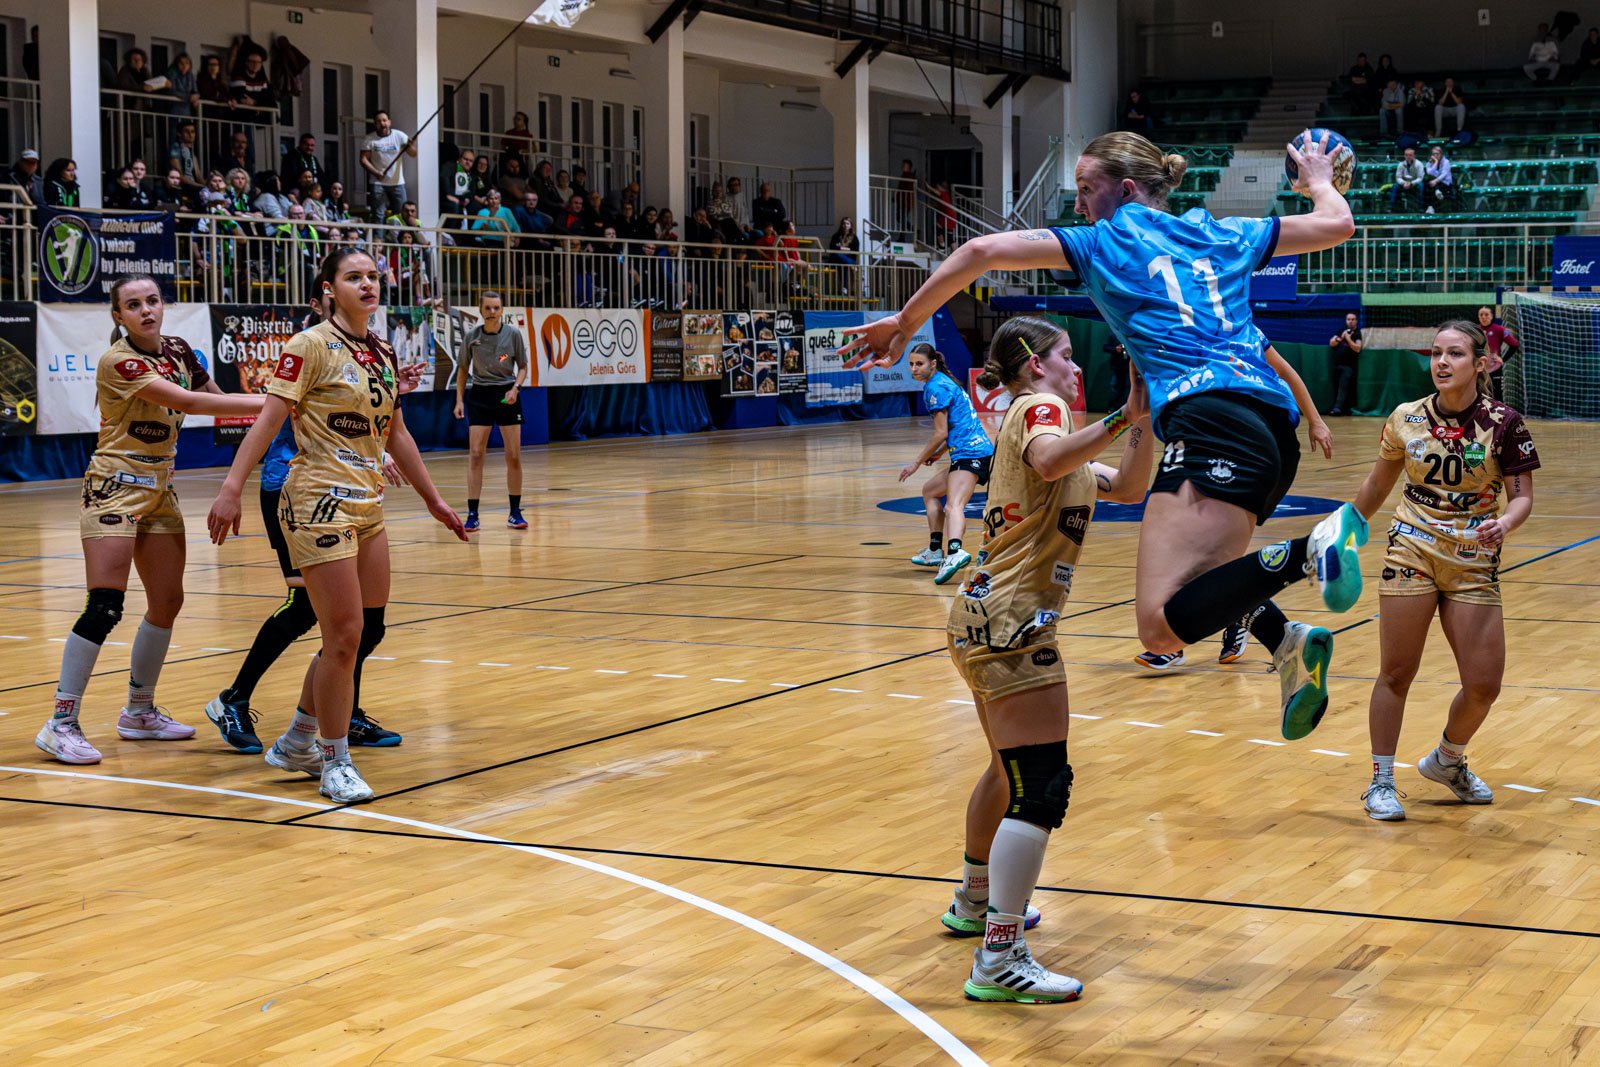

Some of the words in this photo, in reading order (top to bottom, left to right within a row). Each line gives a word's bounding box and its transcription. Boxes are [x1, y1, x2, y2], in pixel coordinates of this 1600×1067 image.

[140, 220, 164, 234] moc
[107, 239, 135, 253] wiara
[101, 258, 114, 274] by
[115, 258, 150, 274] Jelenia
[152, 258, 174, 275] Góra
[1555, 259, 1595, 274] Hotel
[1146, 255, 1233, 332] 11
[241, 316, 294, 338] Pizzeria
[653, 316, 680, 332] Catering
[572, 318, 638, 358] eco
[809, 329, 836, 354] quest
[217, 333, 285, 364] Gazow
[48, 354, 96, 372] JEL
[589, 362, 614, 377] Jelenia
[616, 361, 637, 375] Góra
[367, 377, 382, 408] 5
[334, 416, 369, 431] elmas
[1405, 415, 1424, 423] TICO
[134, 424, 167, 438] elmas
[1164, 440, 1185, 464] 11
[1517, 440, 1534, 455] KP
[1424, 453, 1463, 487] 20
